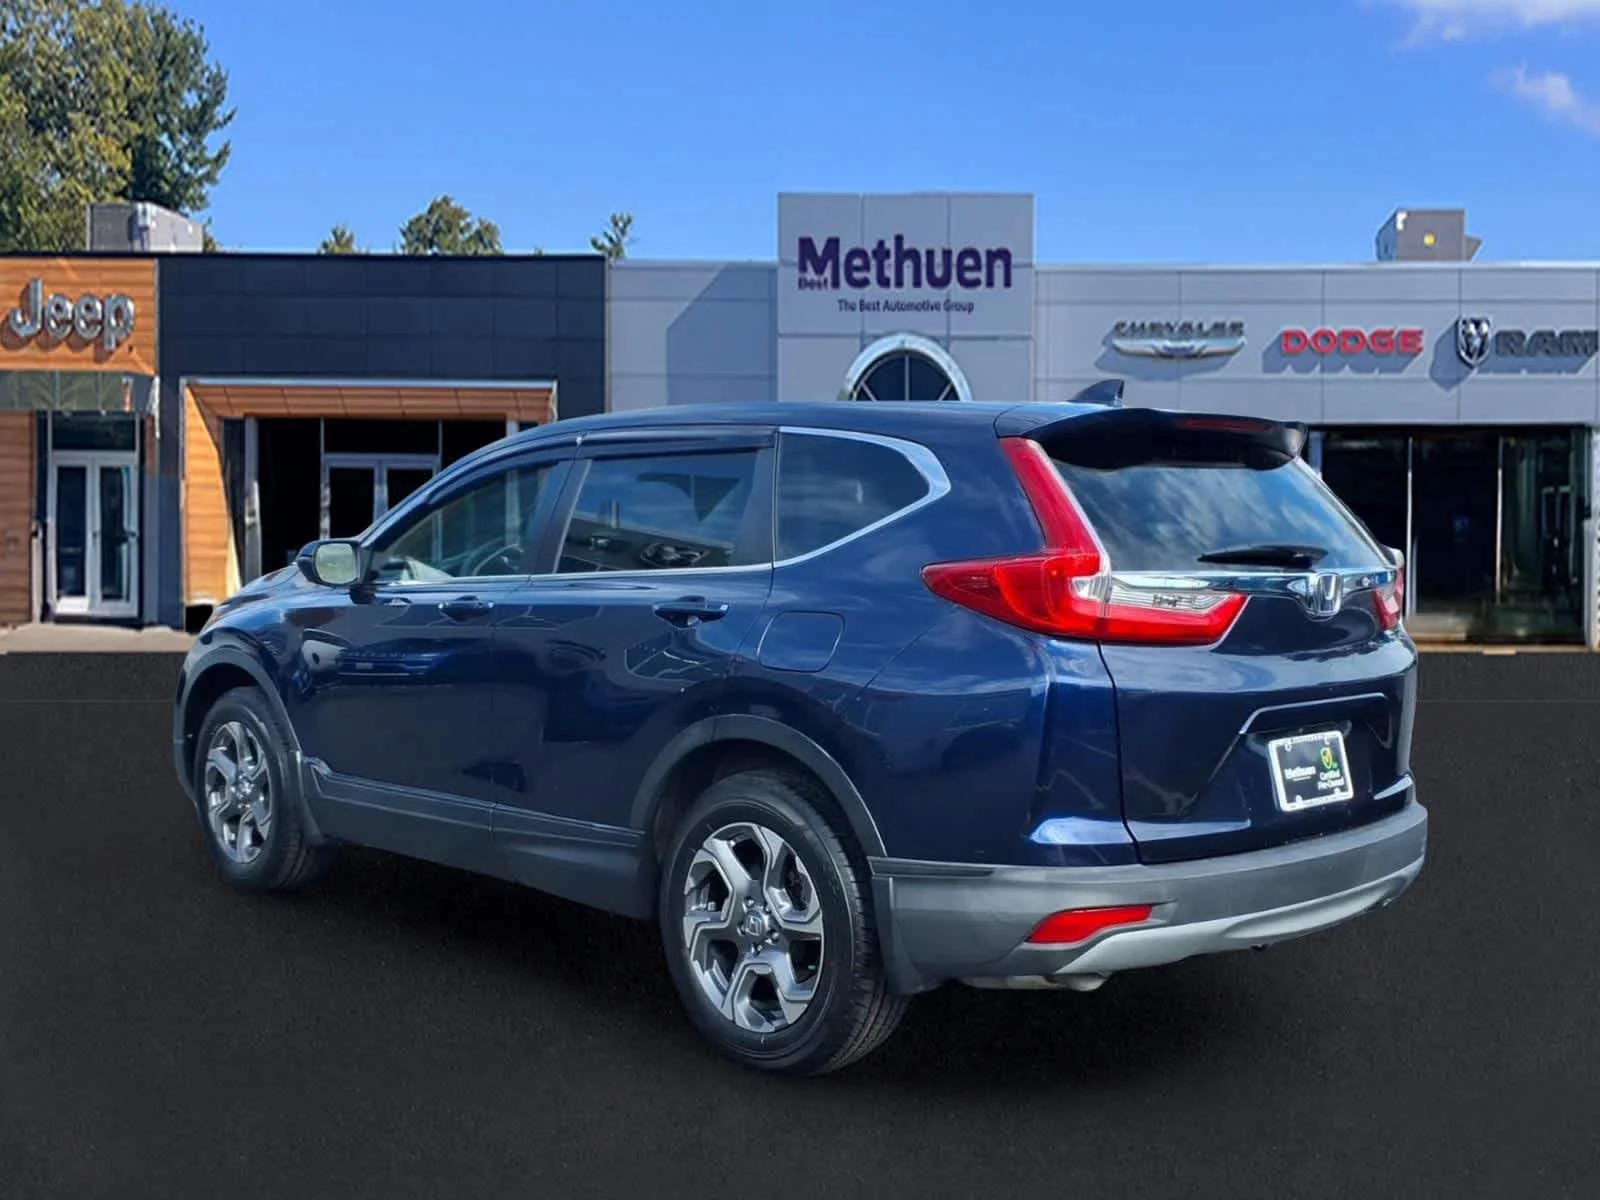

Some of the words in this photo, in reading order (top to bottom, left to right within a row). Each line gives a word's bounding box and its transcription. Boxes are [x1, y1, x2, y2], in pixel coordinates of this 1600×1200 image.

[798, 234, 1012, 290] Methuen
[798, 276, 829, 290] Best
[9, 278, 135, 351] Jeep
[838, 299, 857, 312] The
[859, 299, 881, 313] Best
[883, 299, 942, 313] Automotive
[943, 299, 975, 315] Group
[1112, 321, 1245, 339] CHRYSLER
[1281, 327, 1424, 355] DODGE
[1494, 329, 1599, 357] RAM
